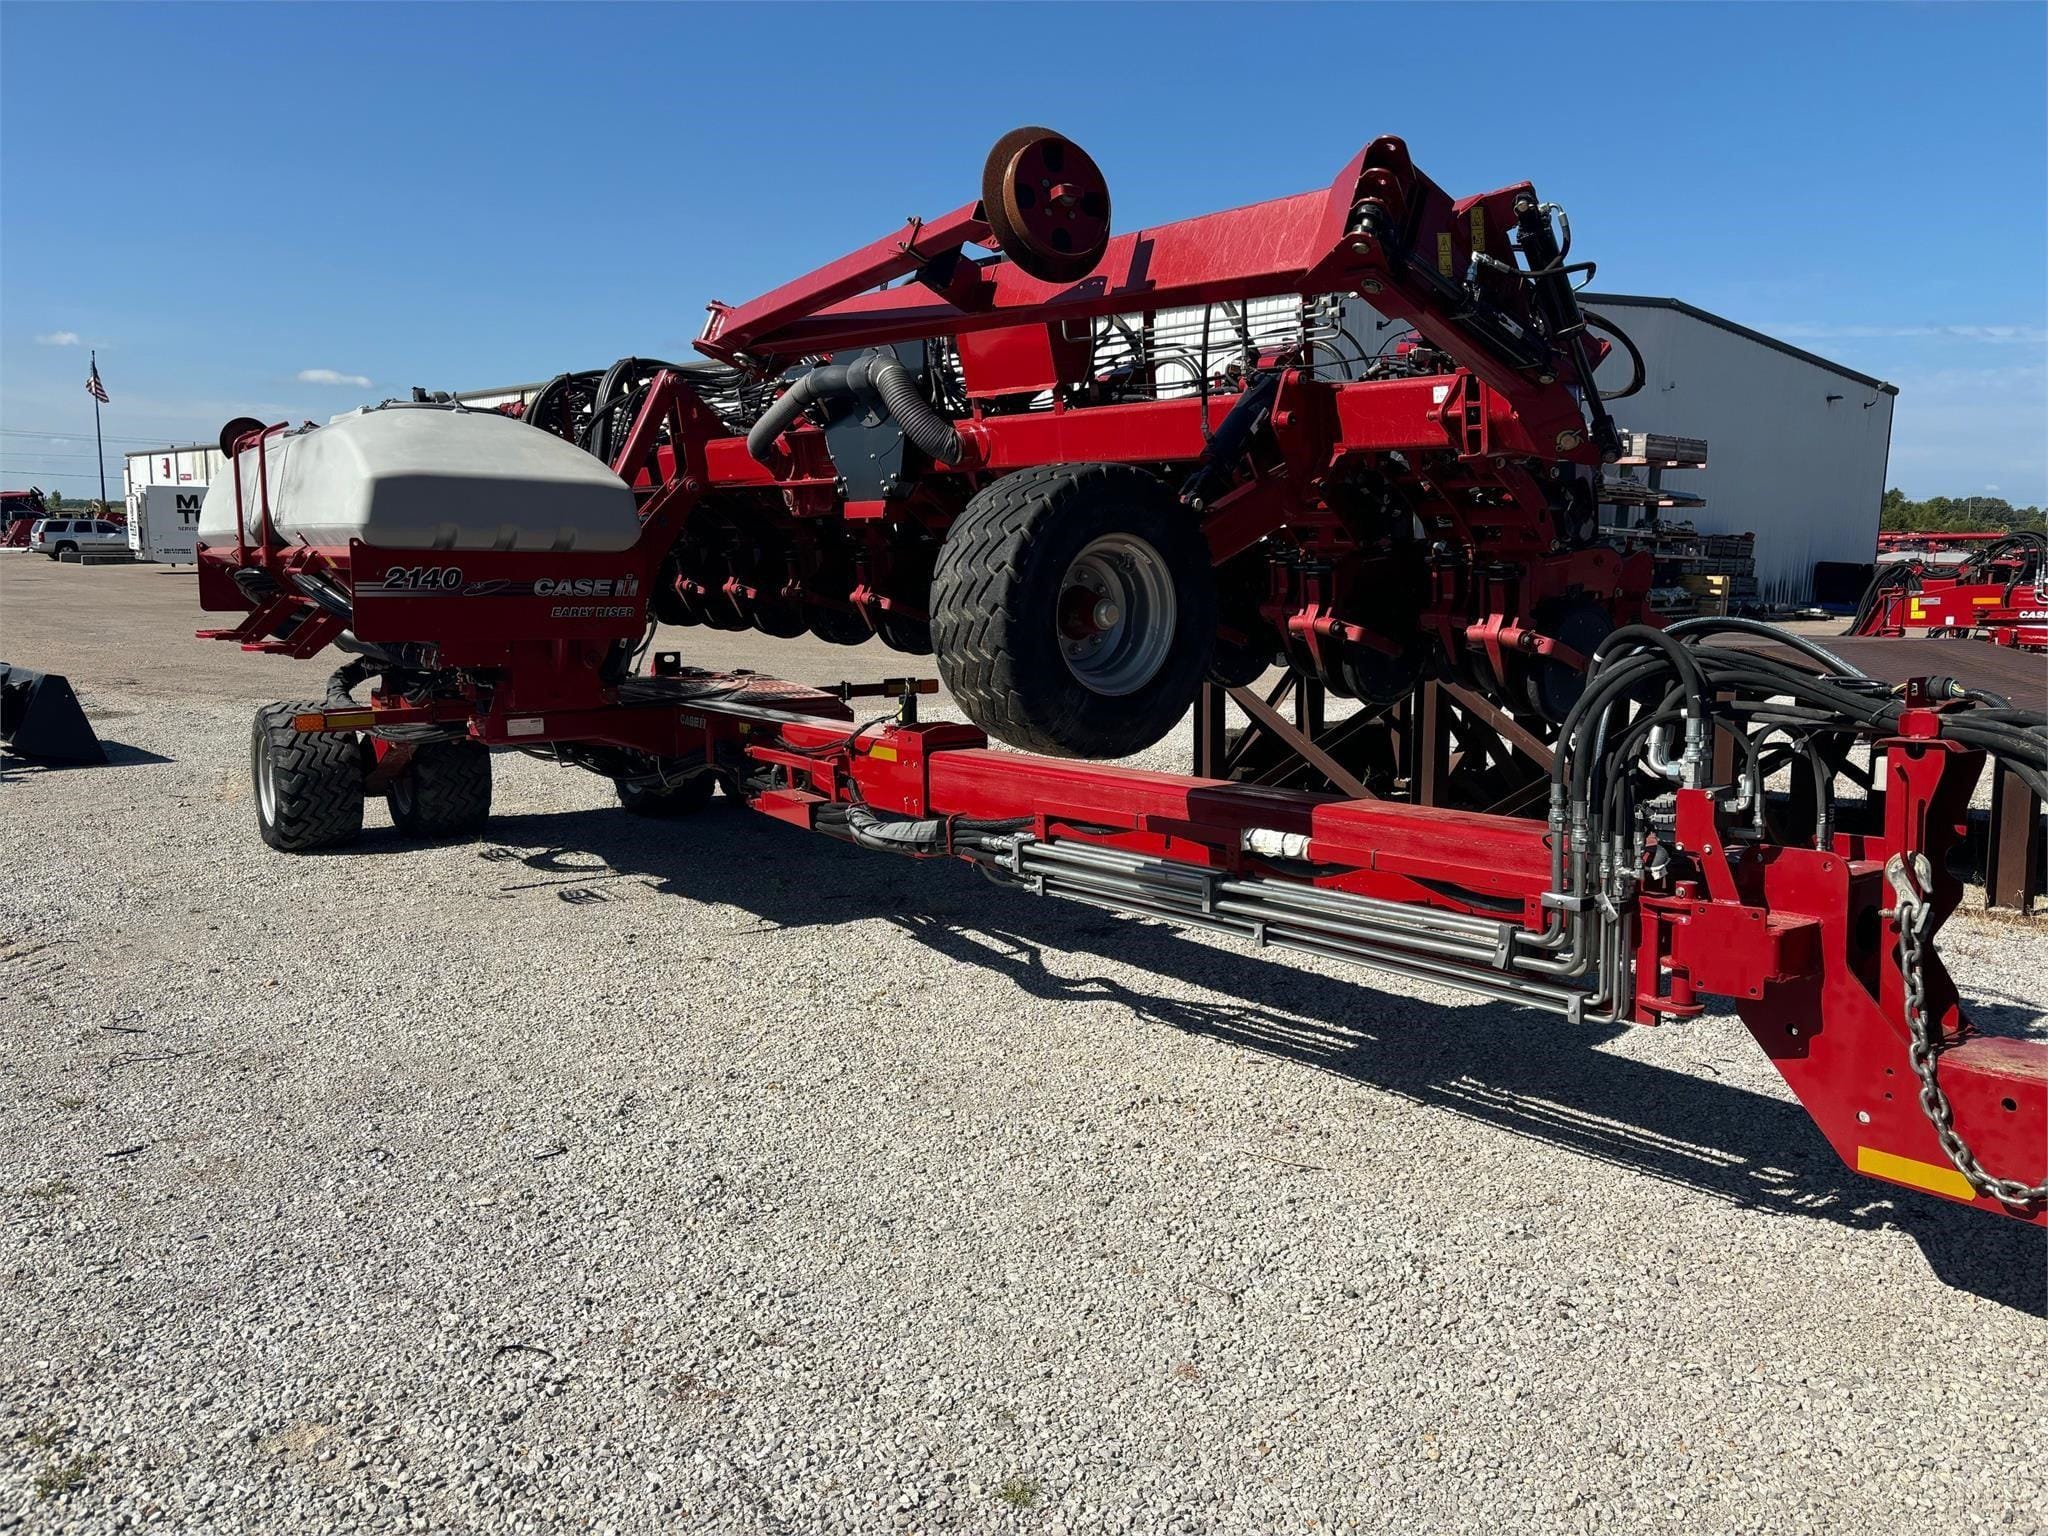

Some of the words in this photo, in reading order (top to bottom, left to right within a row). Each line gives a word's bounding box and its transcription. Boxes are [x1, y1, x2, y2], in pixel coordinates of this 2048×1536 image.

[176, 494, 202, 508] M
[383, 567, 463, 590] 2140
[533, 578, 611, 596] CASE
[551, 606, 595, 618] EARLY
[595, 606, 635, 617] RISER
